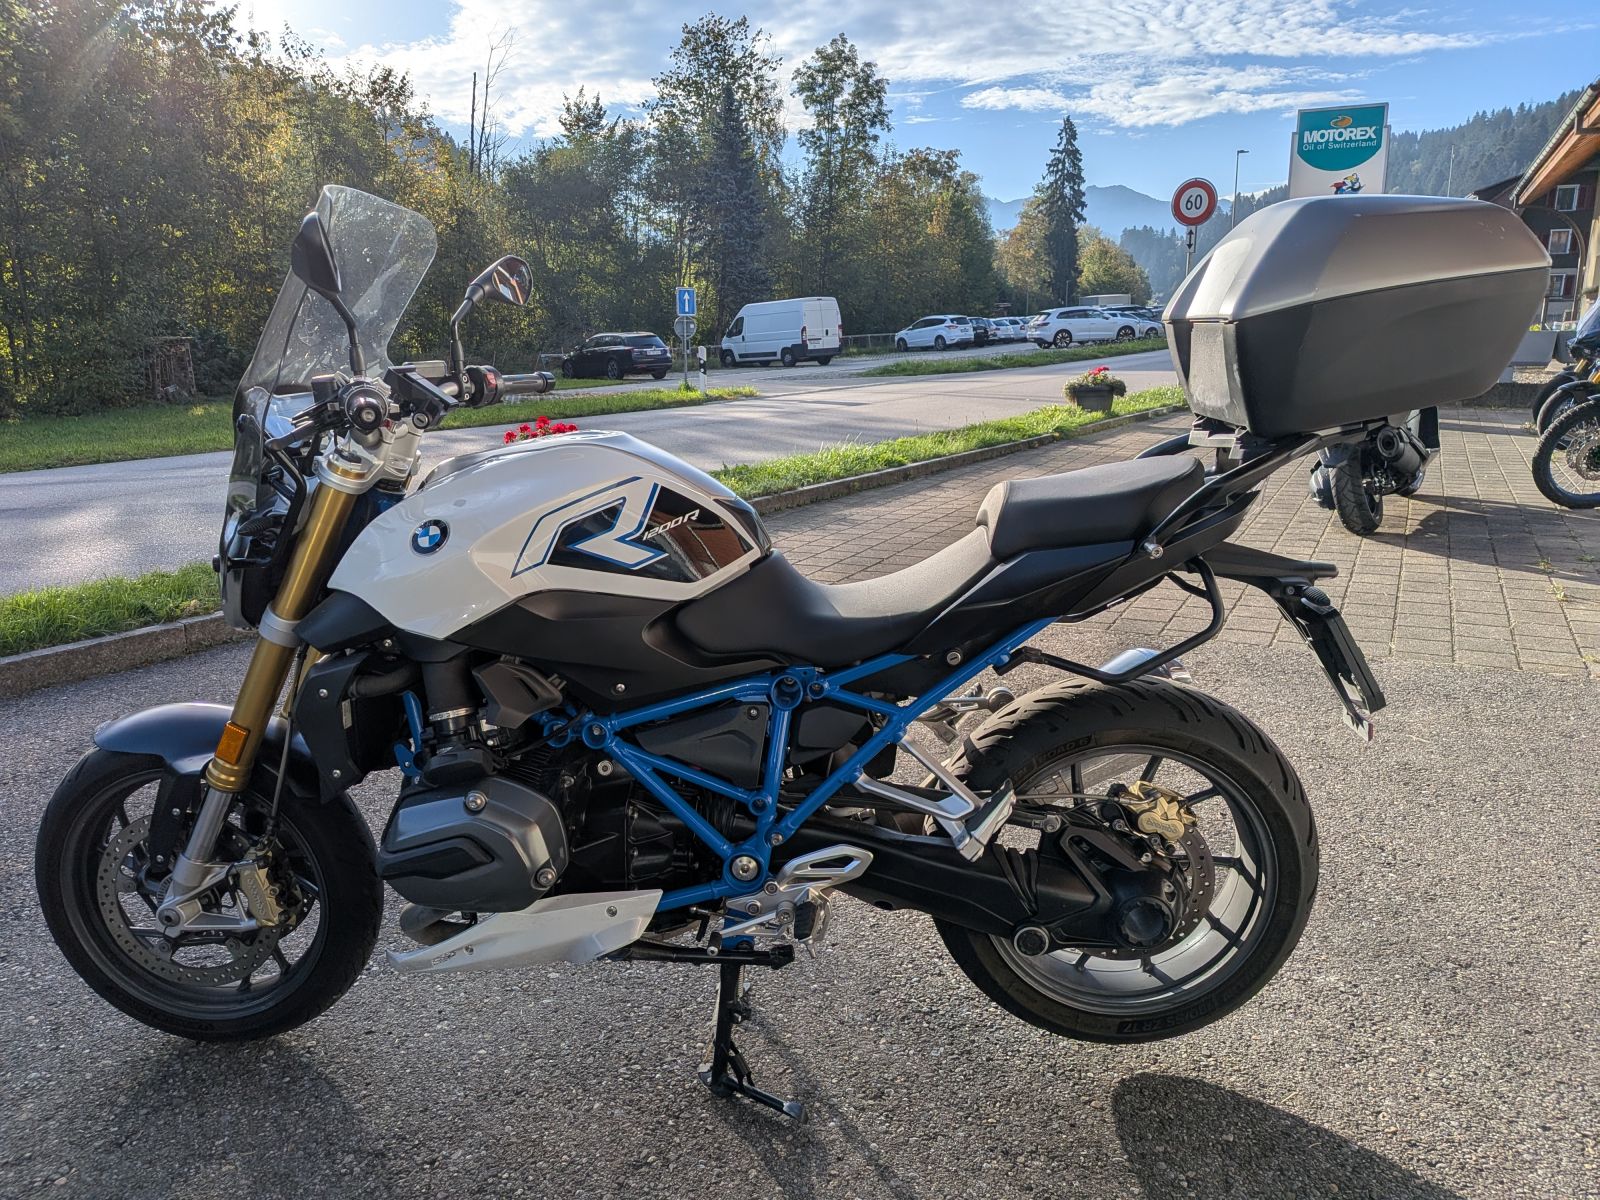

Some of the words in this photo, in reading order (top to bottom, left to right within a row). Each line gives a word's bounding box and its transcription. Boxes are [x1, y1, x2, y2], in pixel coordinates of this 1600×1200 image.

[1303, 126, 1377, 144] MOTOREX
[1302, 143, 1314, 151] Oil
[1316, 142, 1326, 150] of
[1327, 140, 1377, 150] Switzerland
[1185, 193, 1203, 211] 60
